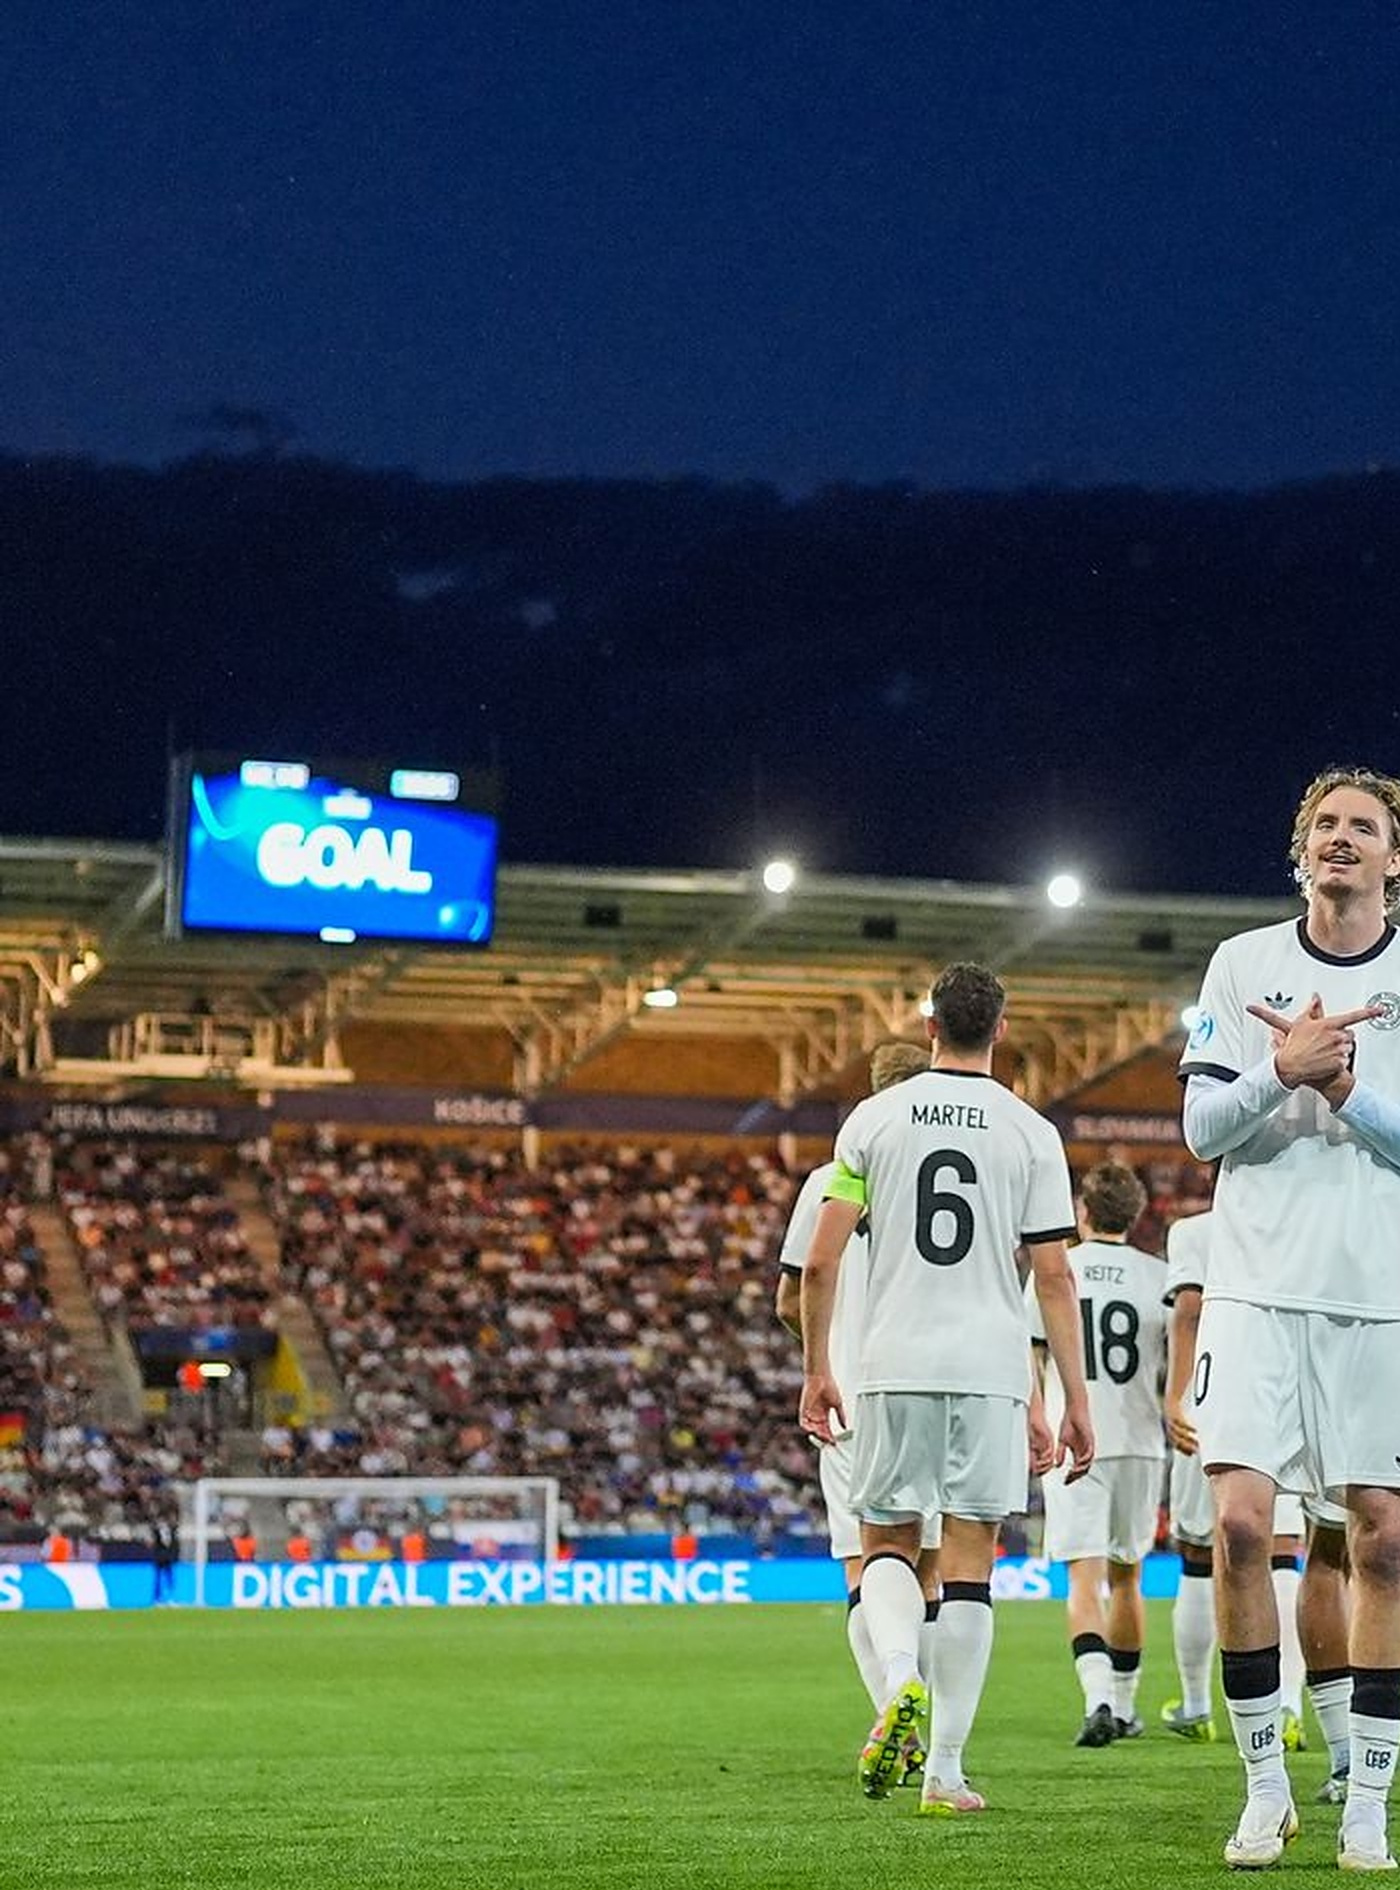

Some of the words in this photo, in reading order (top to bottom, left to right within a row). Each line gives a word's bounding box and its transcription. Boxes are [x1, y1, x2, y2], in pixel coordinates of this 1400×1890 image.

[257, 823, 432, 893] GOAL
[911, 1104, 989, 1129] MARTEL
[915, 1148, 977, 1266] 6
[1080, 1297, 1139, 1384] 18
[232, 1563, 435, 1609] DIGITAL
[448, 1560, 751, 1606] EXPERIENCE
